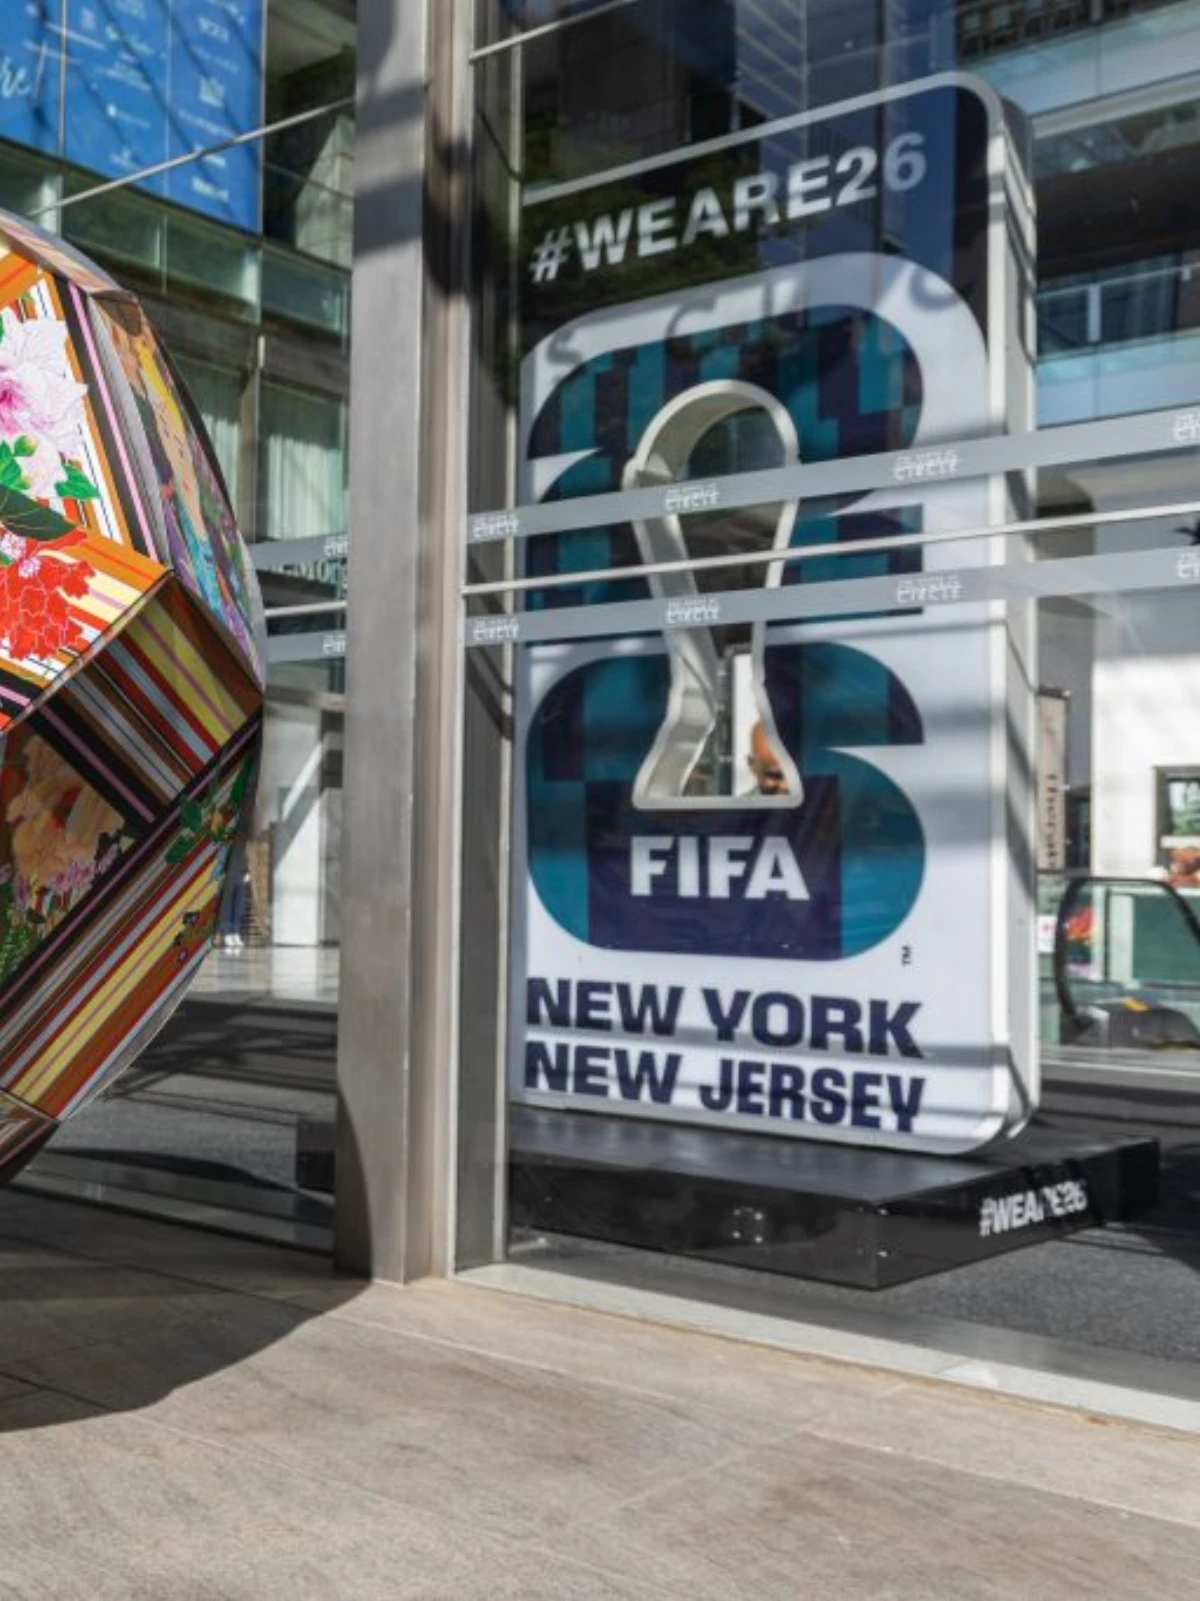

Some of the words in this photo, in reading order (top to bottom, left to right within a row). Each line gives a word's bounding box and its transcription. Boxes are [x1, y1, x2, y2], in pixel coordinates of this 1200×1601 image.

[529, 132, 927, 284] #WEARE26
[630, 835, 810, 901] FIFA
[526, 976, 684, 1036] NEW
[702, 988, 925, 1059] YORK
[524, 1041, 682, 1105] NEW
[699, 1058, 926, 1134] JERSEY
